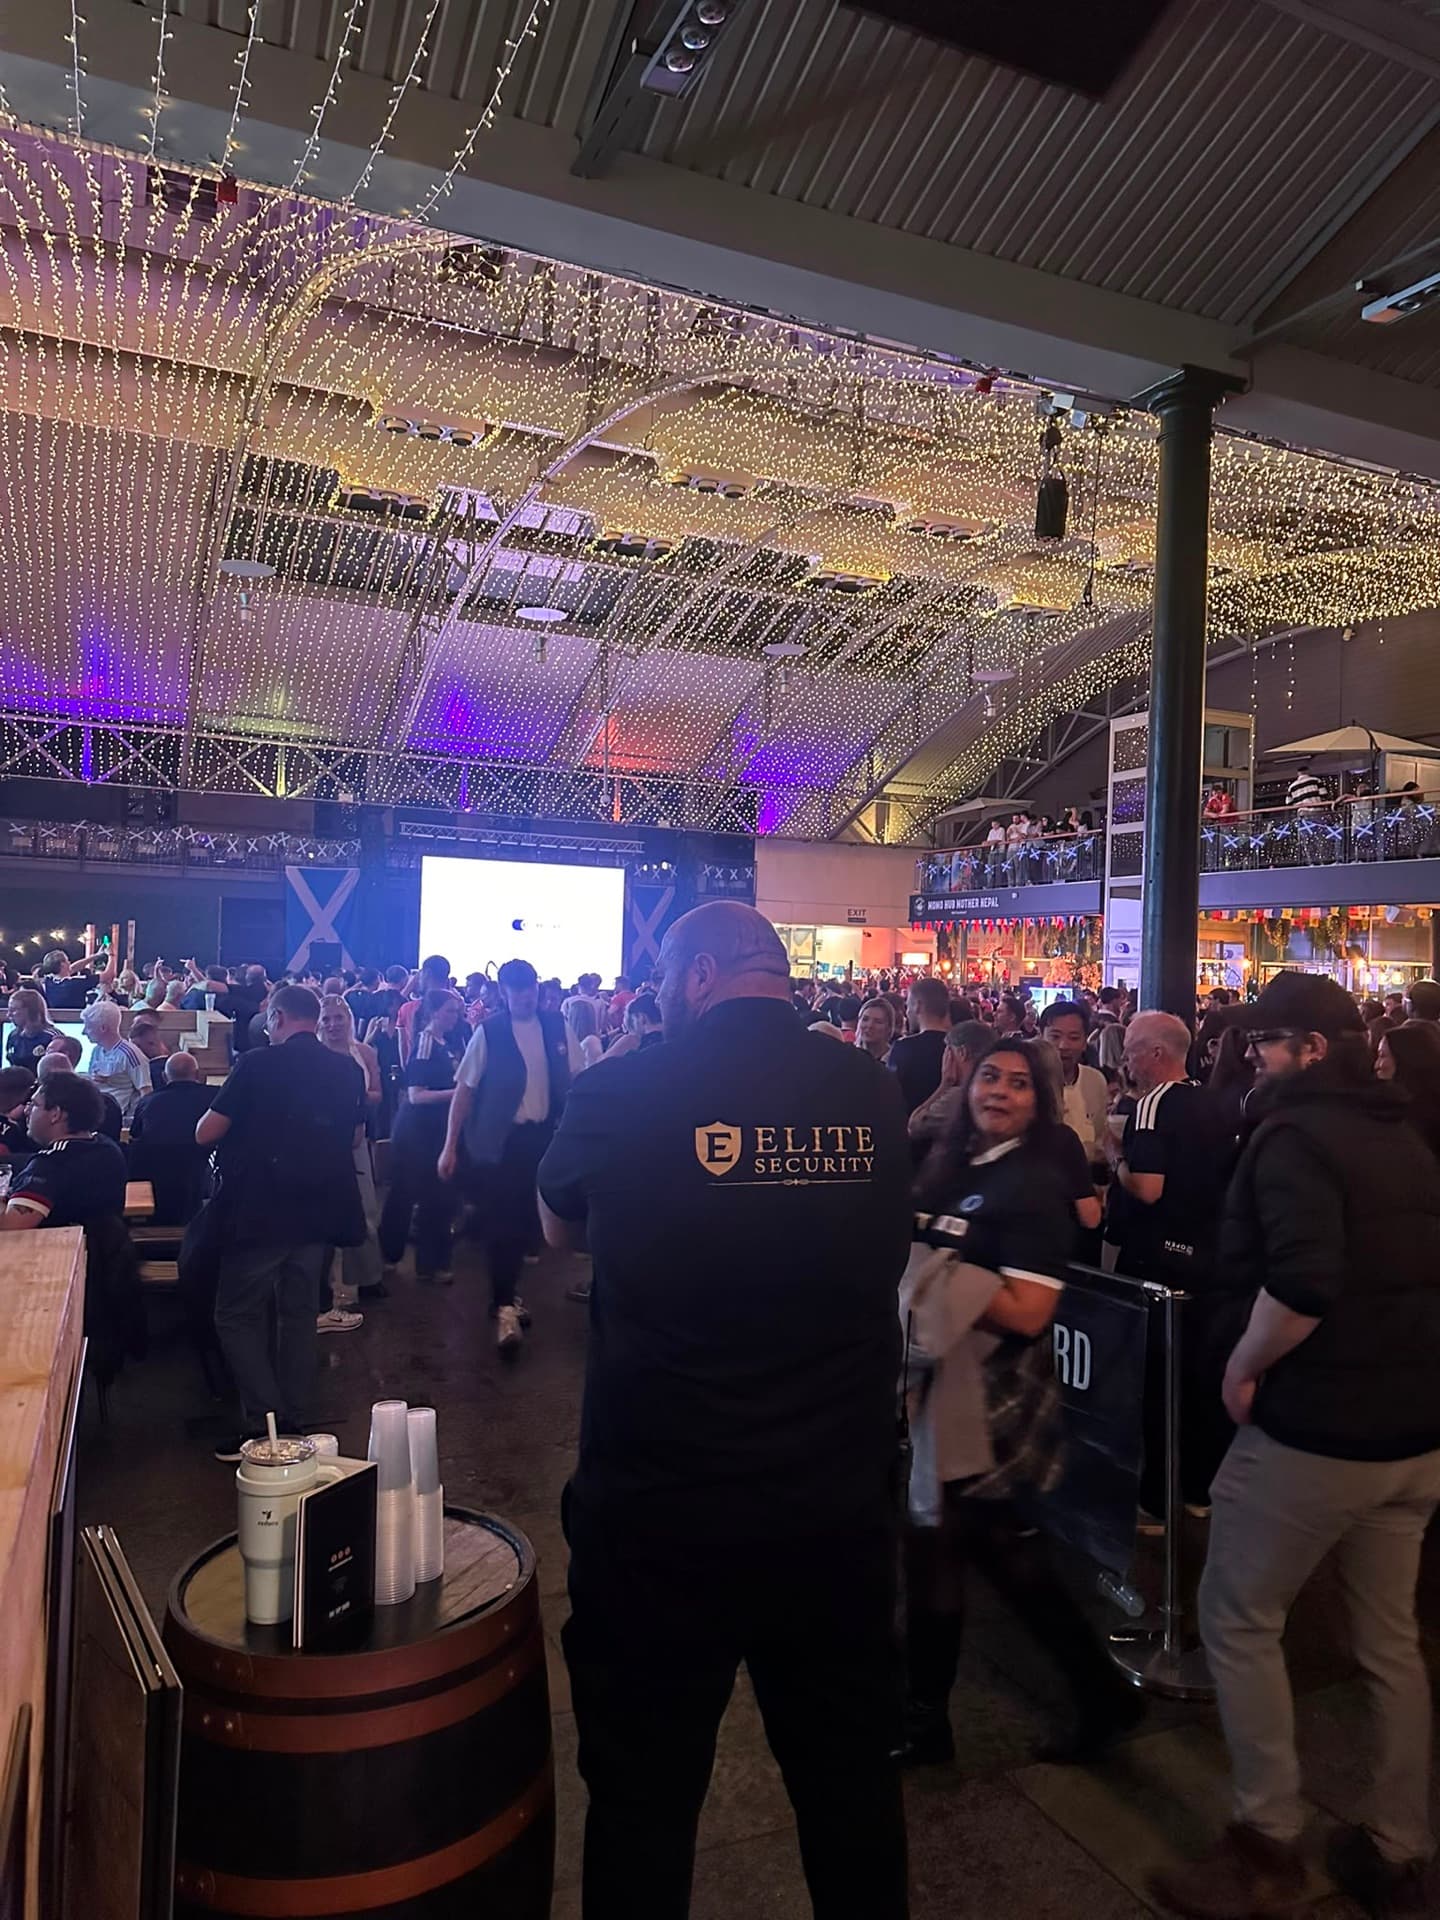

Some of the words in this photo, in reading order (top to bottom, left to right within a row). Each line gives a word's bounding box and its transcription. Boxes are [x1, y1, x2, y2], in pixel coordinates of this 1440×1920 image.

[847, 908, 867, 917] EXIT
[705, 1132, 734, 1163] E
[754, 1126, 875, 1154] ELITE
[754, 1156, 875, 1174] SECURITY
